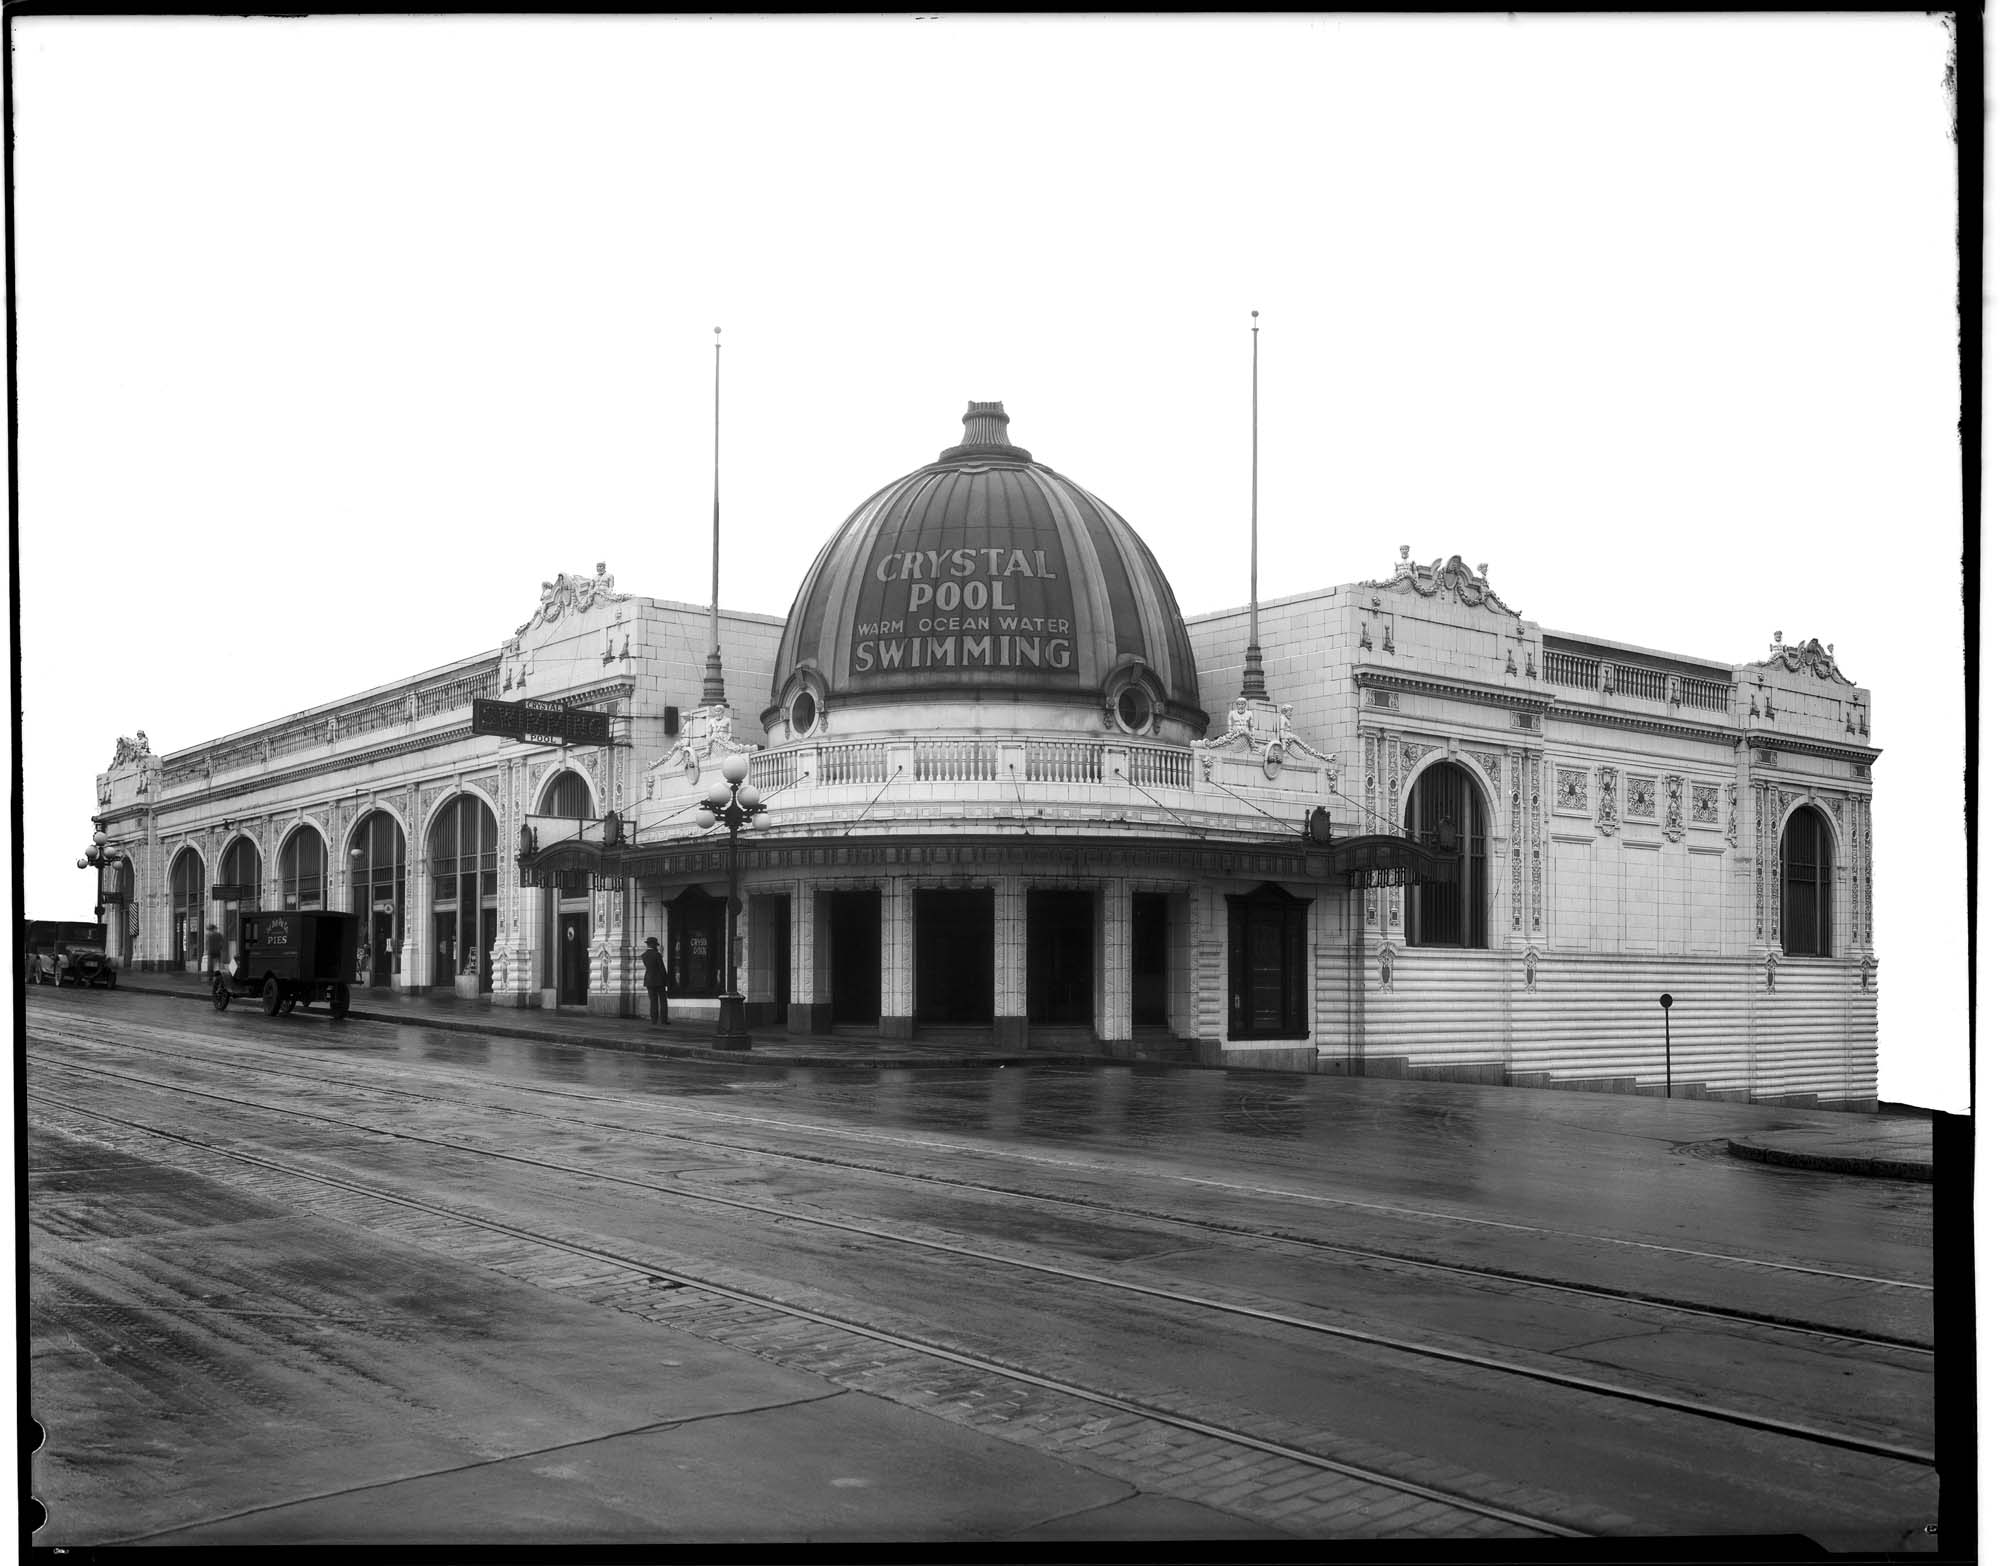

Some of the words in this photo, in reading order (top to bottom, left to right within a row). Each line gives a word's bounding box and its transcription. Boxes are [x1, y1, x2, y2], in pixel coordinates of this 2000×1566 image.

[876, 549, 1057, 582] CRYSTAL
[908, 580, 1016, 612] POOL
[858, 619, 904, 636] WARM
[918, 616, 990, 632] OCEAN
[999, 616, 1069, 634] WATER
[855, 635, 1072, 672] SWIMMING
[527, 702, 562, 712] CRYSTAL
[530, 735, 556, 744] POOL
[267, 936, 288, 945] PIES
